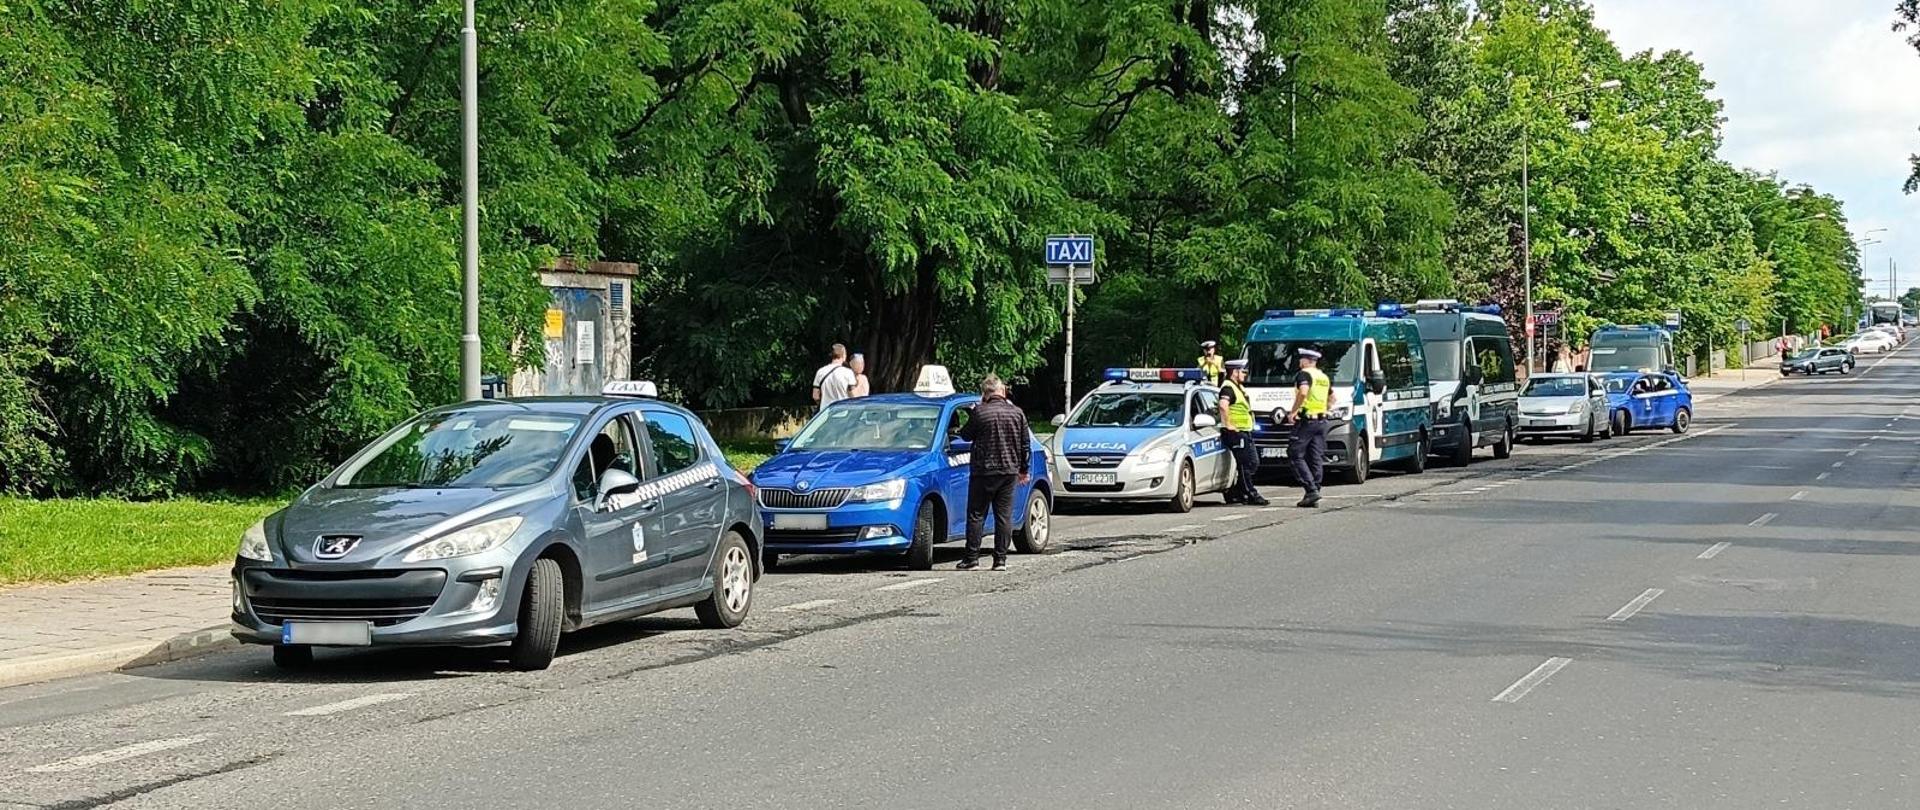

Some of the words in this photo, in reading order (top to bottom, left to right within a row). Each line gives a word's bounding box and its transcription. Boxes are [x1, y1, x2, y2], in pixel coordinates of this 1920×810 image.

[1047, 241, 1090, 260] TAXI
[1533, 313, 1555, 324] TAXI
[1130, 369, 1159, 378] POLICJA
[611, 383, 646, 391] TAXI
[1068, 442, 1127, 450] POLICJA
